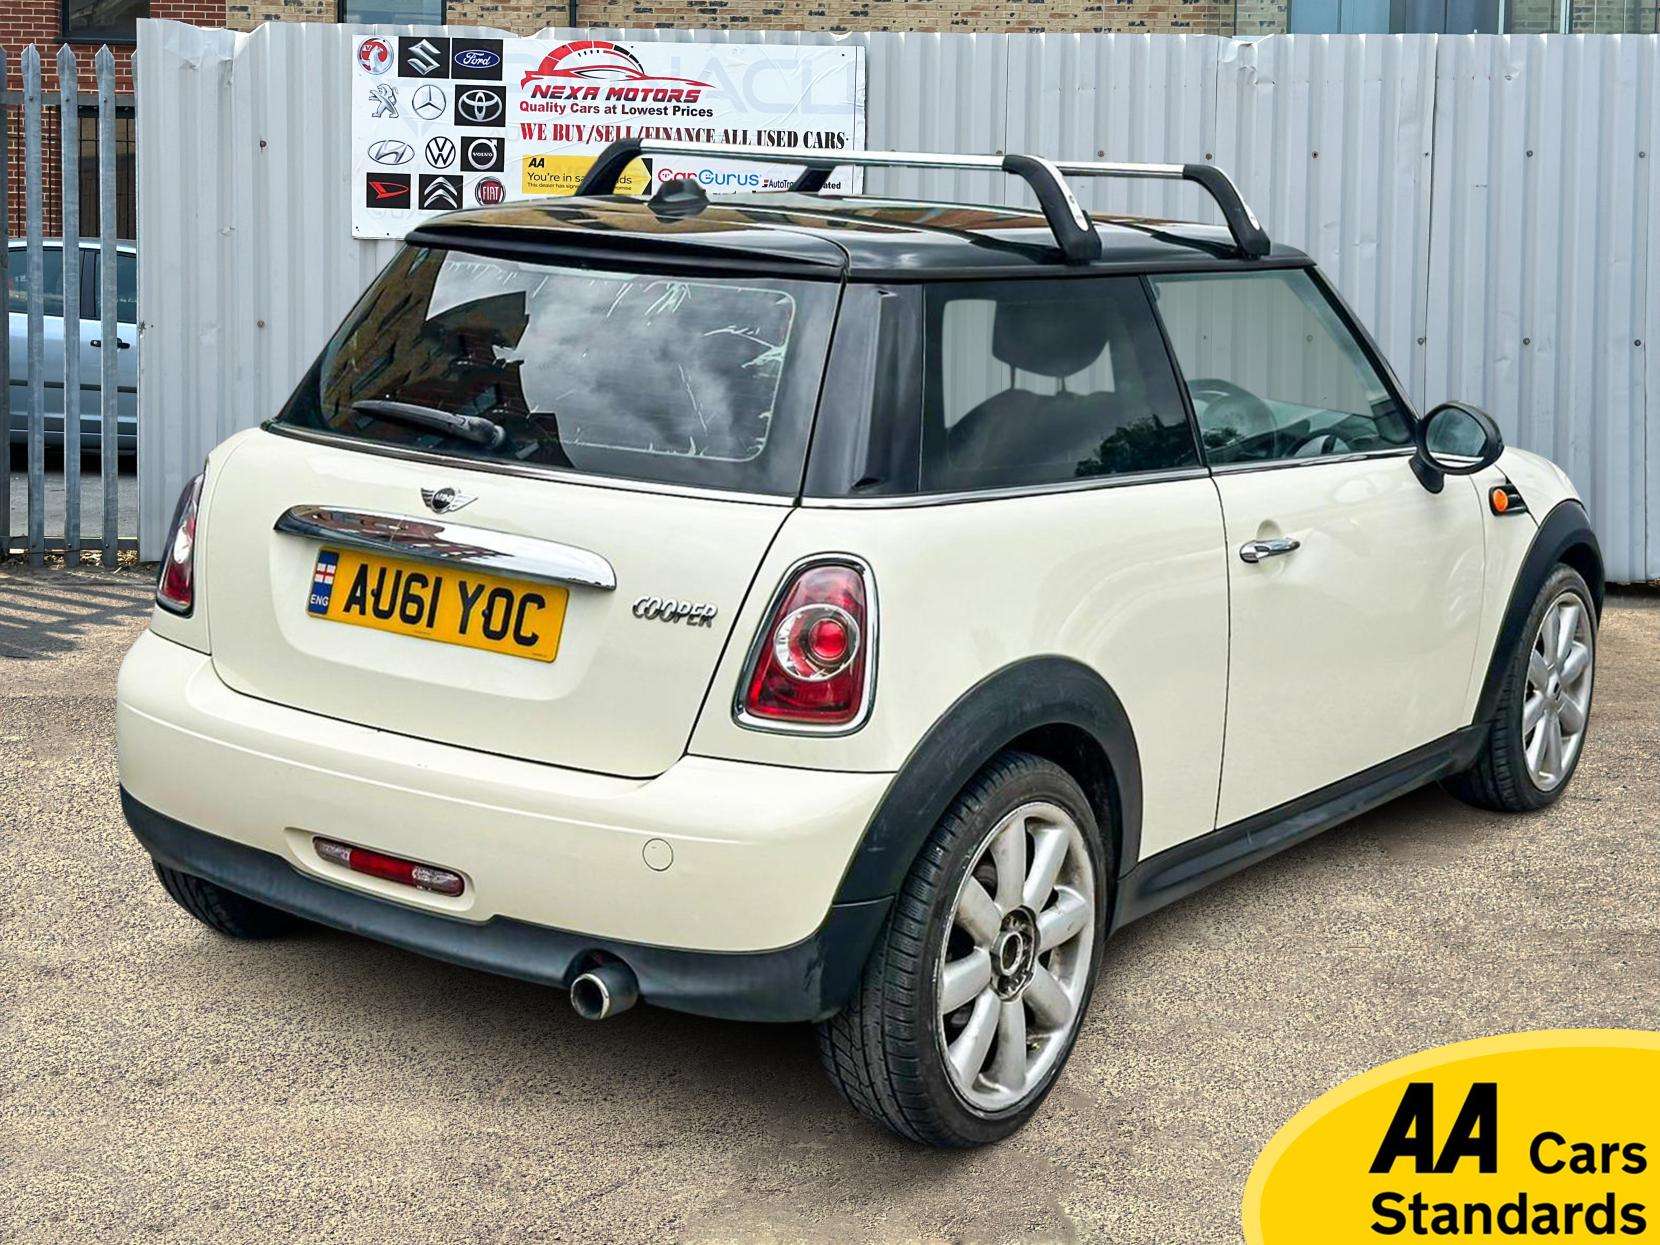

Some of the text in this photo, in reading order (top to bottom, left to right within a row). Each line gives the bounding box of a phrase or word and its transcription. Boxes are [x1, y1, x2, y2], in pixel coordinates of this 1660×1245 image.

[463, 52, 492, 66] Ford
[531, 84, 702, 104] NEXA MOTORS
[519, 101, 714, 117] Quality Cars at Lowest Prices
[520, 122, 547, 141] WE
[720, 128, 752, 146] ALL
[756, 129, 799, 148] USED
[803, 130, 846, 150] CARS
[528, 157, 546, 168] AA
[527, 172, 561, 182] You're
[563, 173, 573, 182] in
[657, 168, 760, 187] CarGurus
[482, 186, 500, 200] FIAT
[310, 563, 546, 647] ENG AU61 YOC
[632, 595, 719, 628] COOPER
